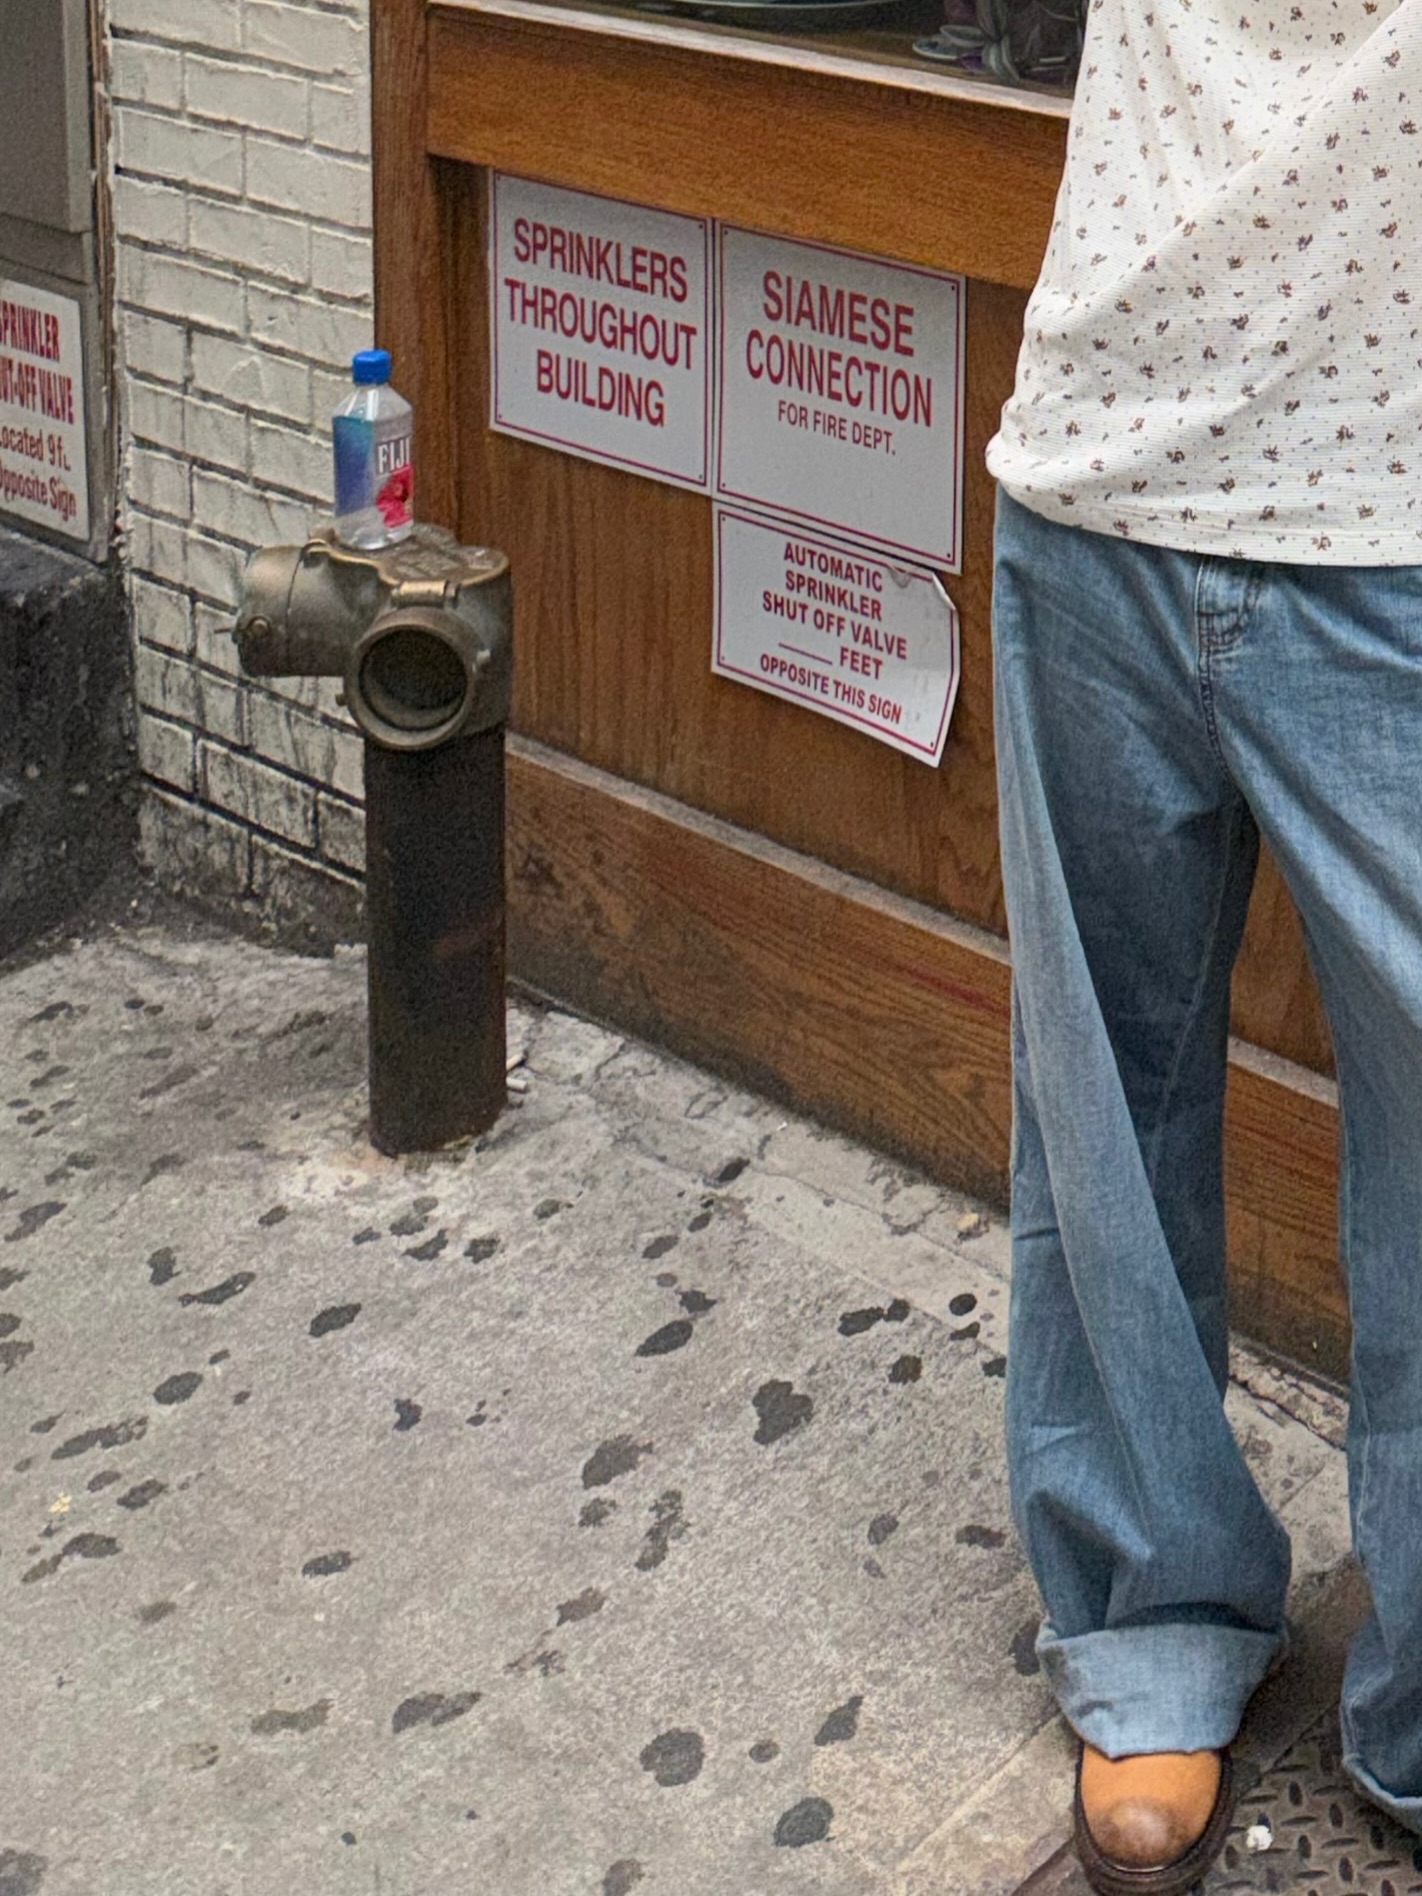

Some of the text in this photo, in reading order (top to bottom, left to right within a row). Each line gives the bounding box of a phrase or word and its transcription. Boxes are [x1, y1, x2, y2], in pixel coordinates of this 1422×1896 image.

[513, 217, 688, 303] SPRINKLERS
[0, 299, 61, 363] PRINKLER
[504, 277, 698, 371] THROUGHOUT
[762, 270, 914, 358] SIAMESE
[0, 355, 74, 425] UT-OFF VALVE
[537, 348, 665, 428] BUILDING
[746, 328, 932, 428] CONNECTION
[0, 425, 44, 462] ocated
[378, 437, 411, 473] FIJI
[778, 399, 896, 456] FOR FIRE DEPT.
[49, 476, 77, 522] Sign
[783, 541, 883, 593] AUTOMATIC
[785, 569, 882, 623] SPRINKLER
[762, 589, 908, 661] SHUT OFF VALVE
[759, 652, 903, 726] OPPOSITE THIS SIGN
[839, 645, 884, 680] FEET
